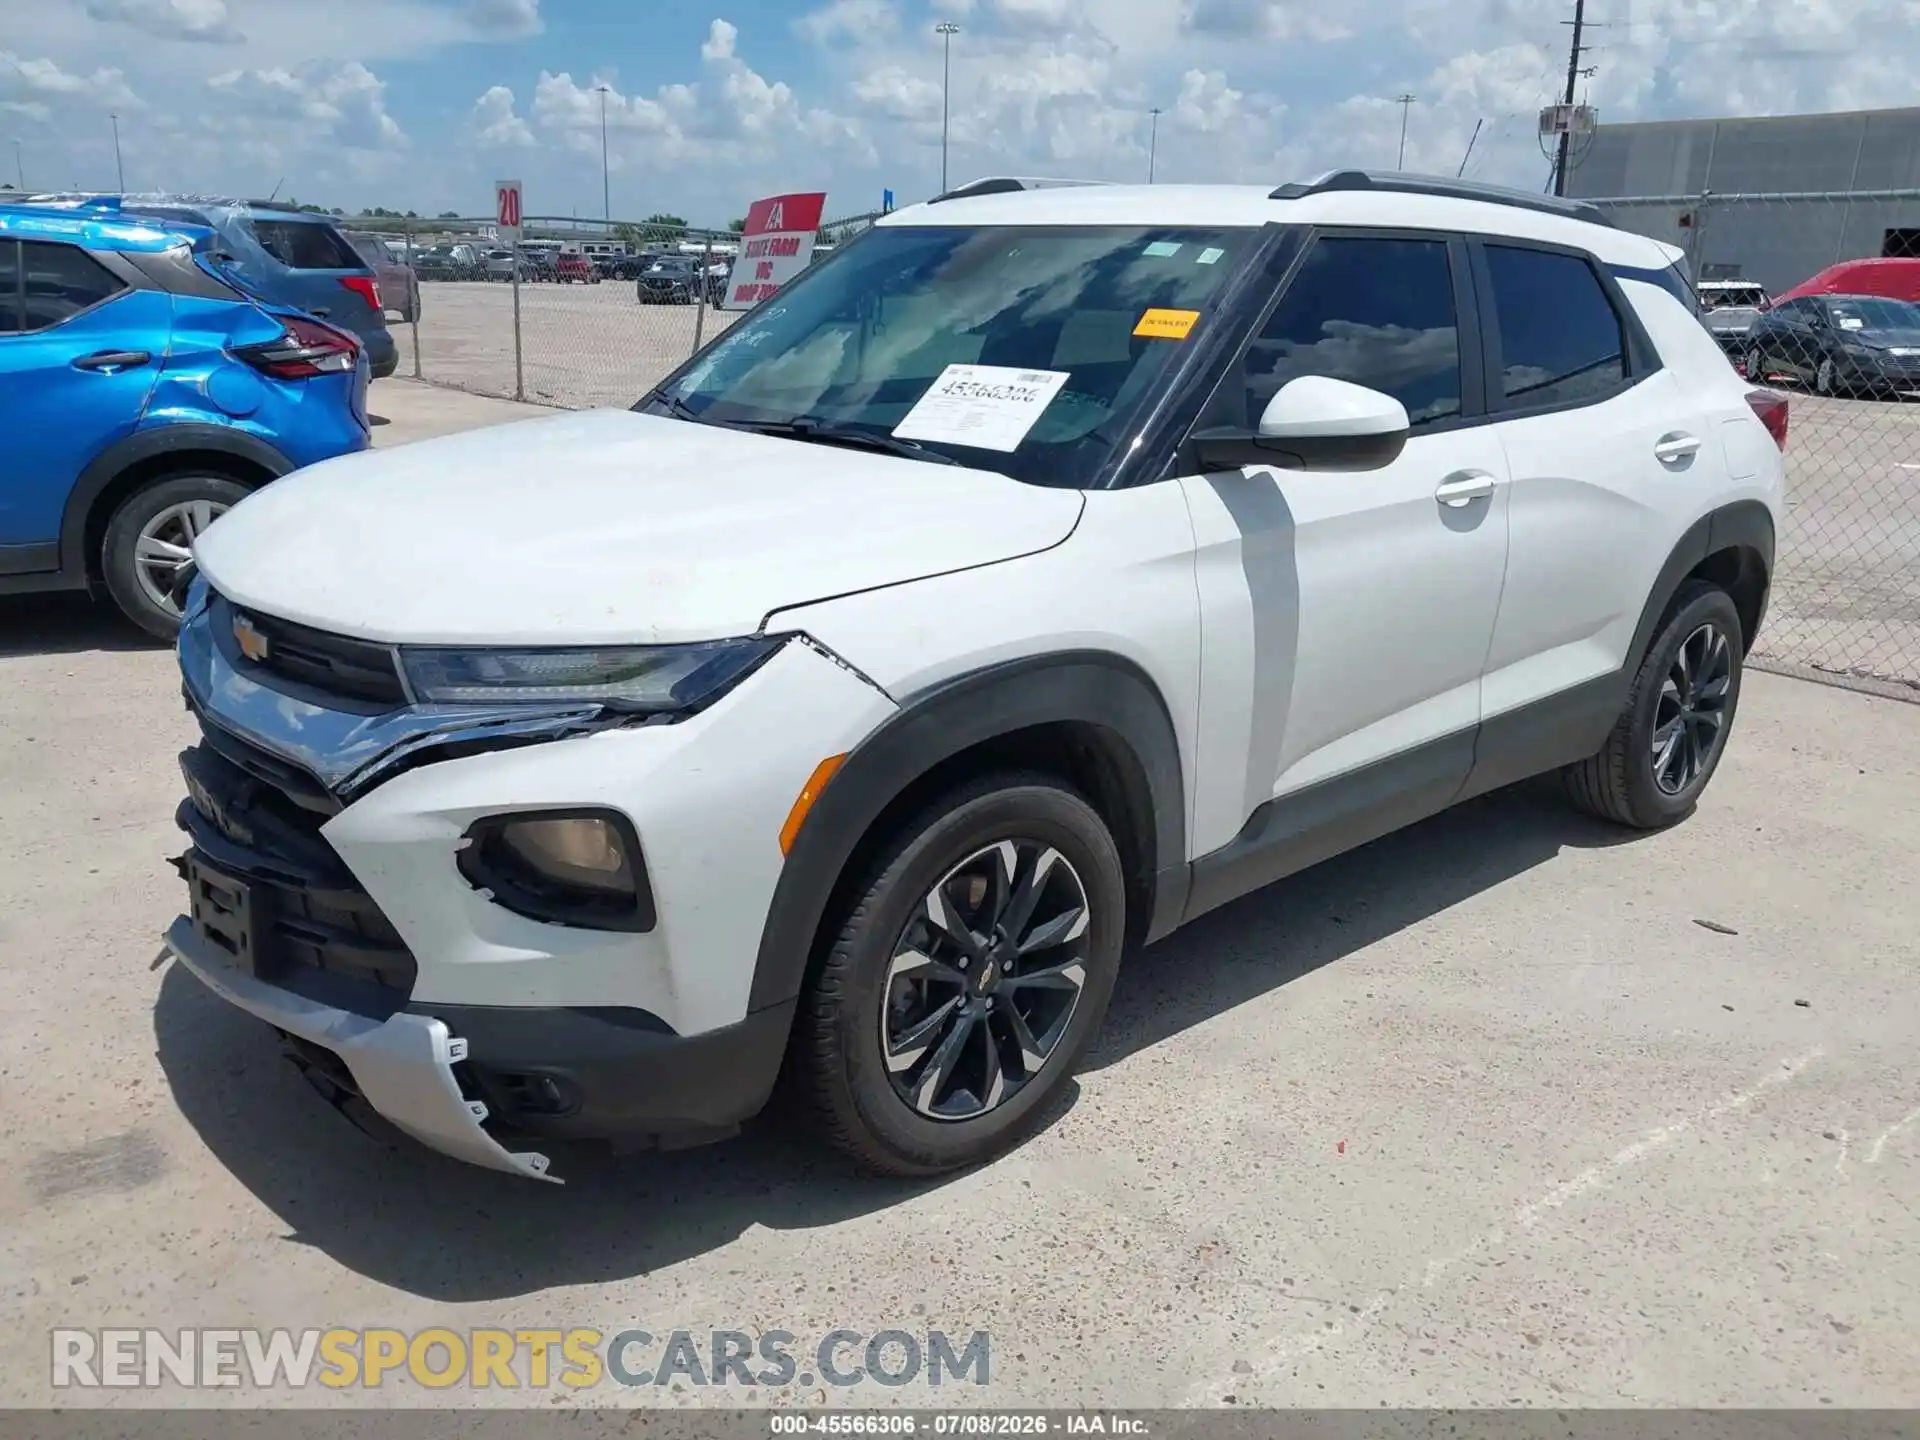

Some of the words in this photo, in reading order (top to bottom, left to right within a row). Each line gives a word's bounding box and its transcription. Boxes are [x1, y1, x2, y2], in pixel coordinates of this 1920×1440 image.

[499, 188, 519, 226] 20
[745, 240, 770, 259] STATE
[768, 237, 801, 257] FARM
